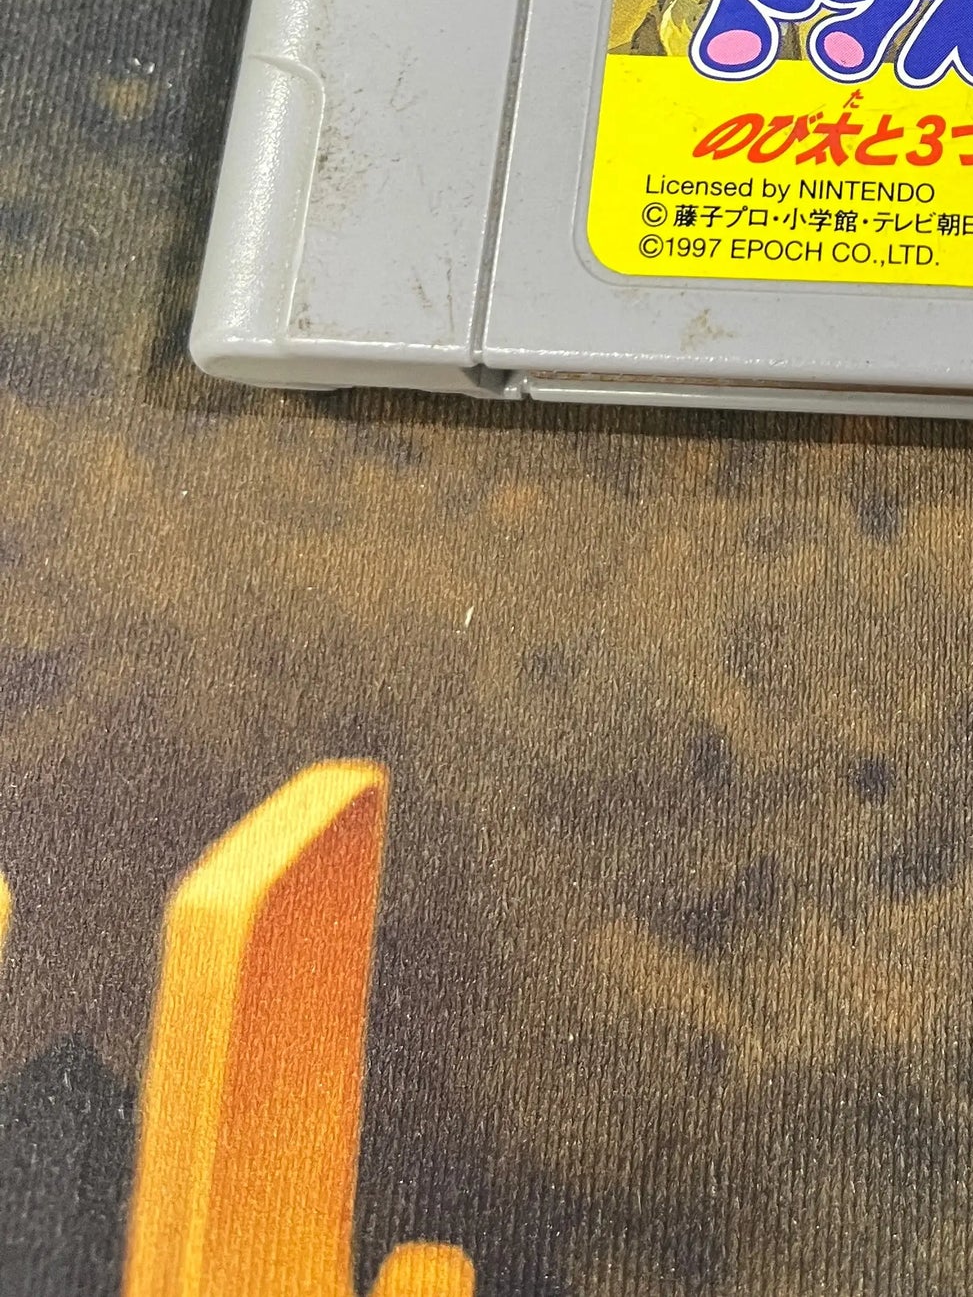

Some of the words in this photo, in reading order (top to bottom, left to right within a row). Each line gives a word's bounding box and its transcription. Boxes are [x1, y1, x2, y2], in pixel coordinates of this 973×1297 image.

[843, 88, 865, 109] た
[645, 175, 753, 197] Licensed
[762, 178, 791, 203] by
[799, 179, 936, 203] NINTENDO
[639, 234, 721, 259] ©1997
[730, 239, 822, 262] EPOCH
